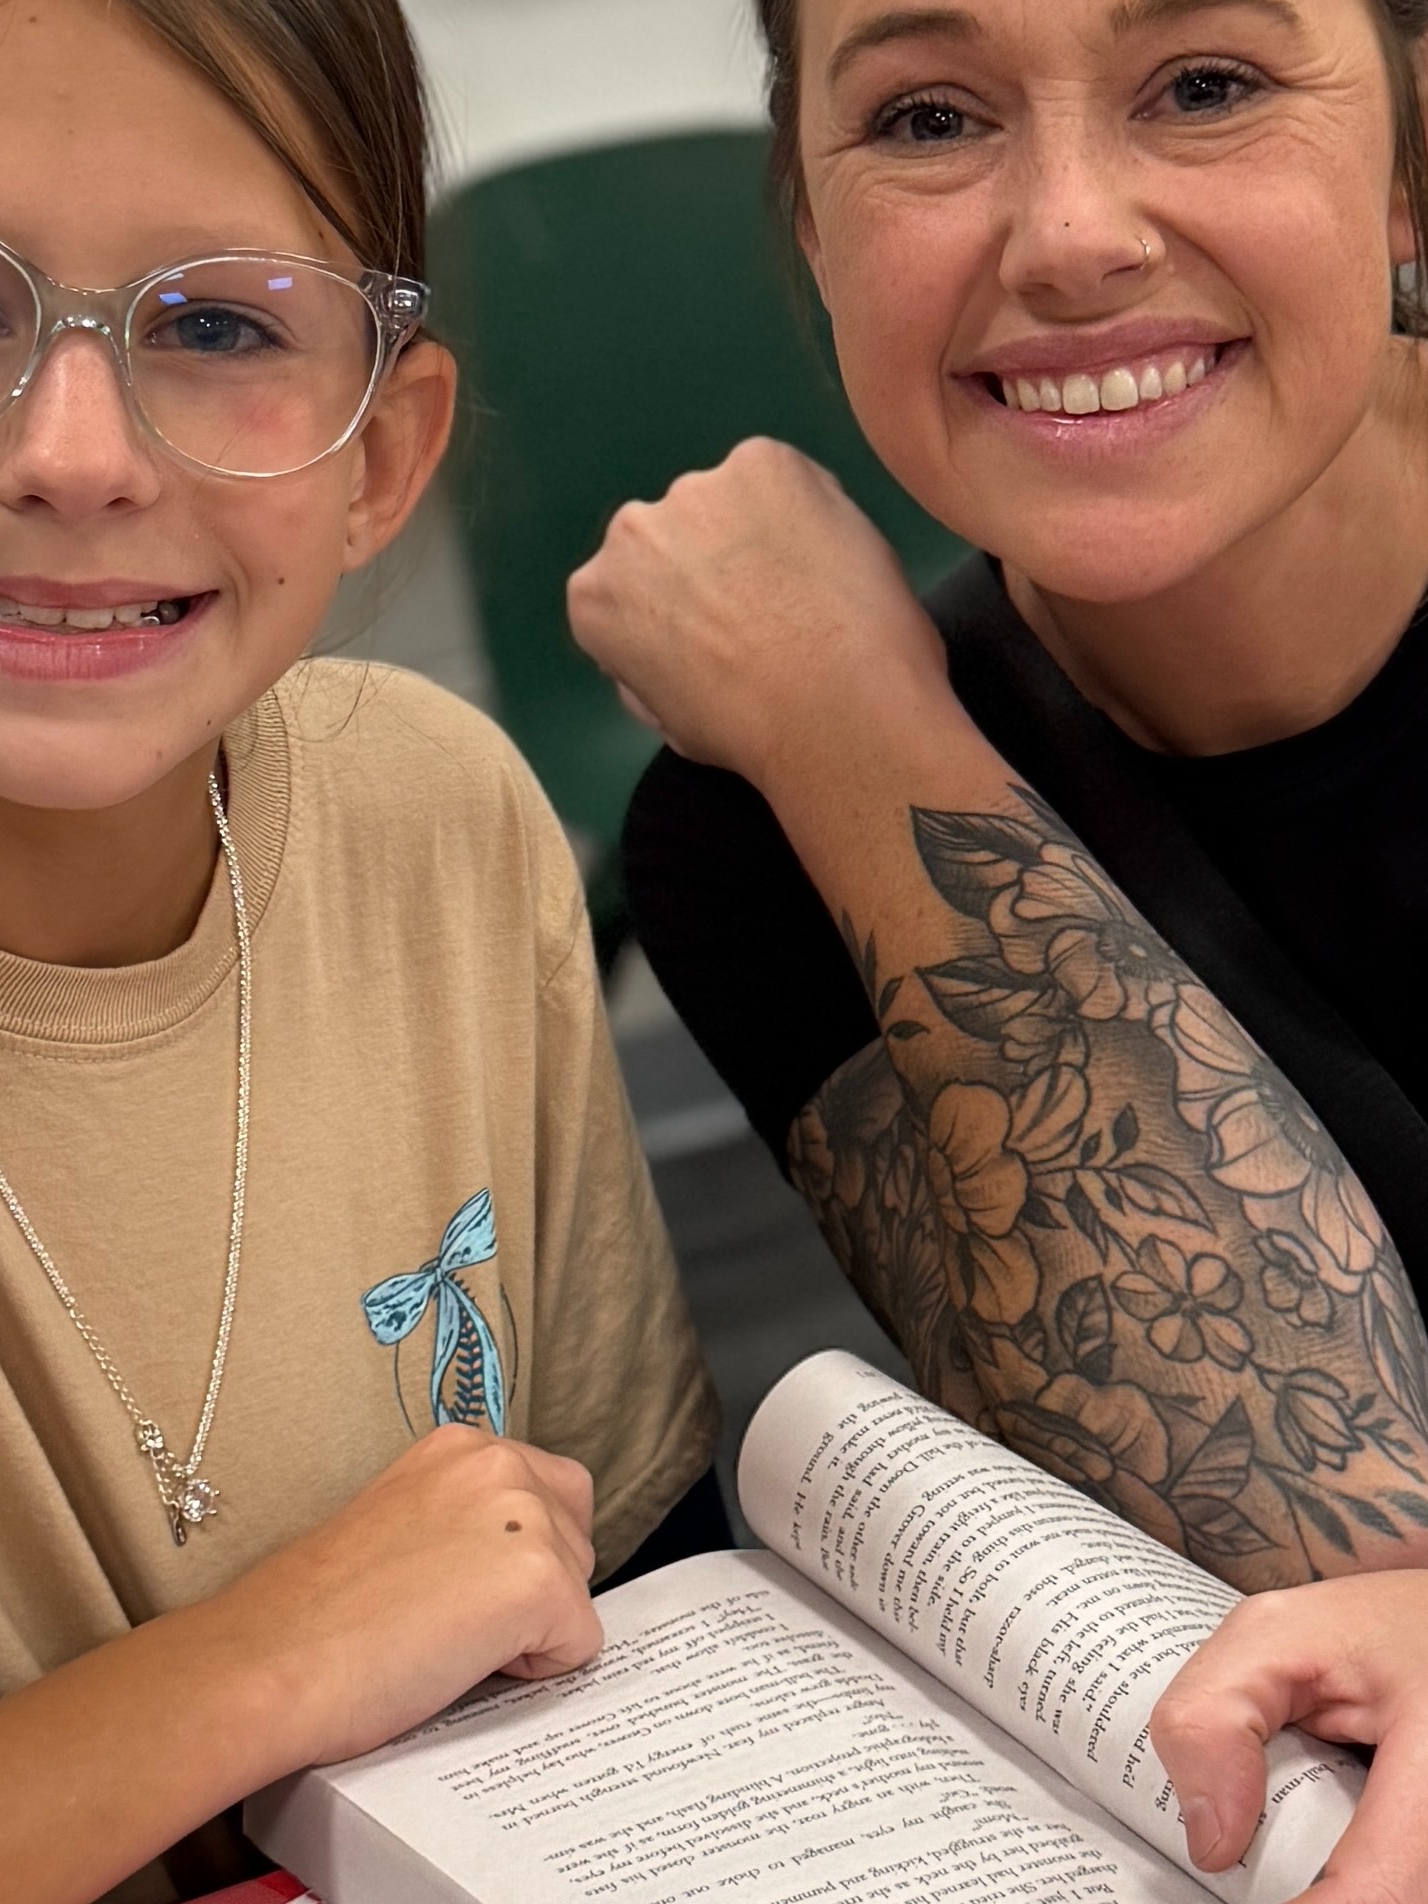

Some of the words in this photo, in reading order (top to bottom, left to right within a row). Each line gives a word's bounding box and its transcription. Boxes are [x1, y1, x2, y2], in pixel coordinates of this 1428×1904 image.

[1034, 1873, 1068, 1885] her.
[1063, 1863, 1118, 1882] charged
[1006, 1881, 1038, 1894] She
[1082, 1882, 1115, 1894] But
[1069, 1888, 1083, 1901] I
